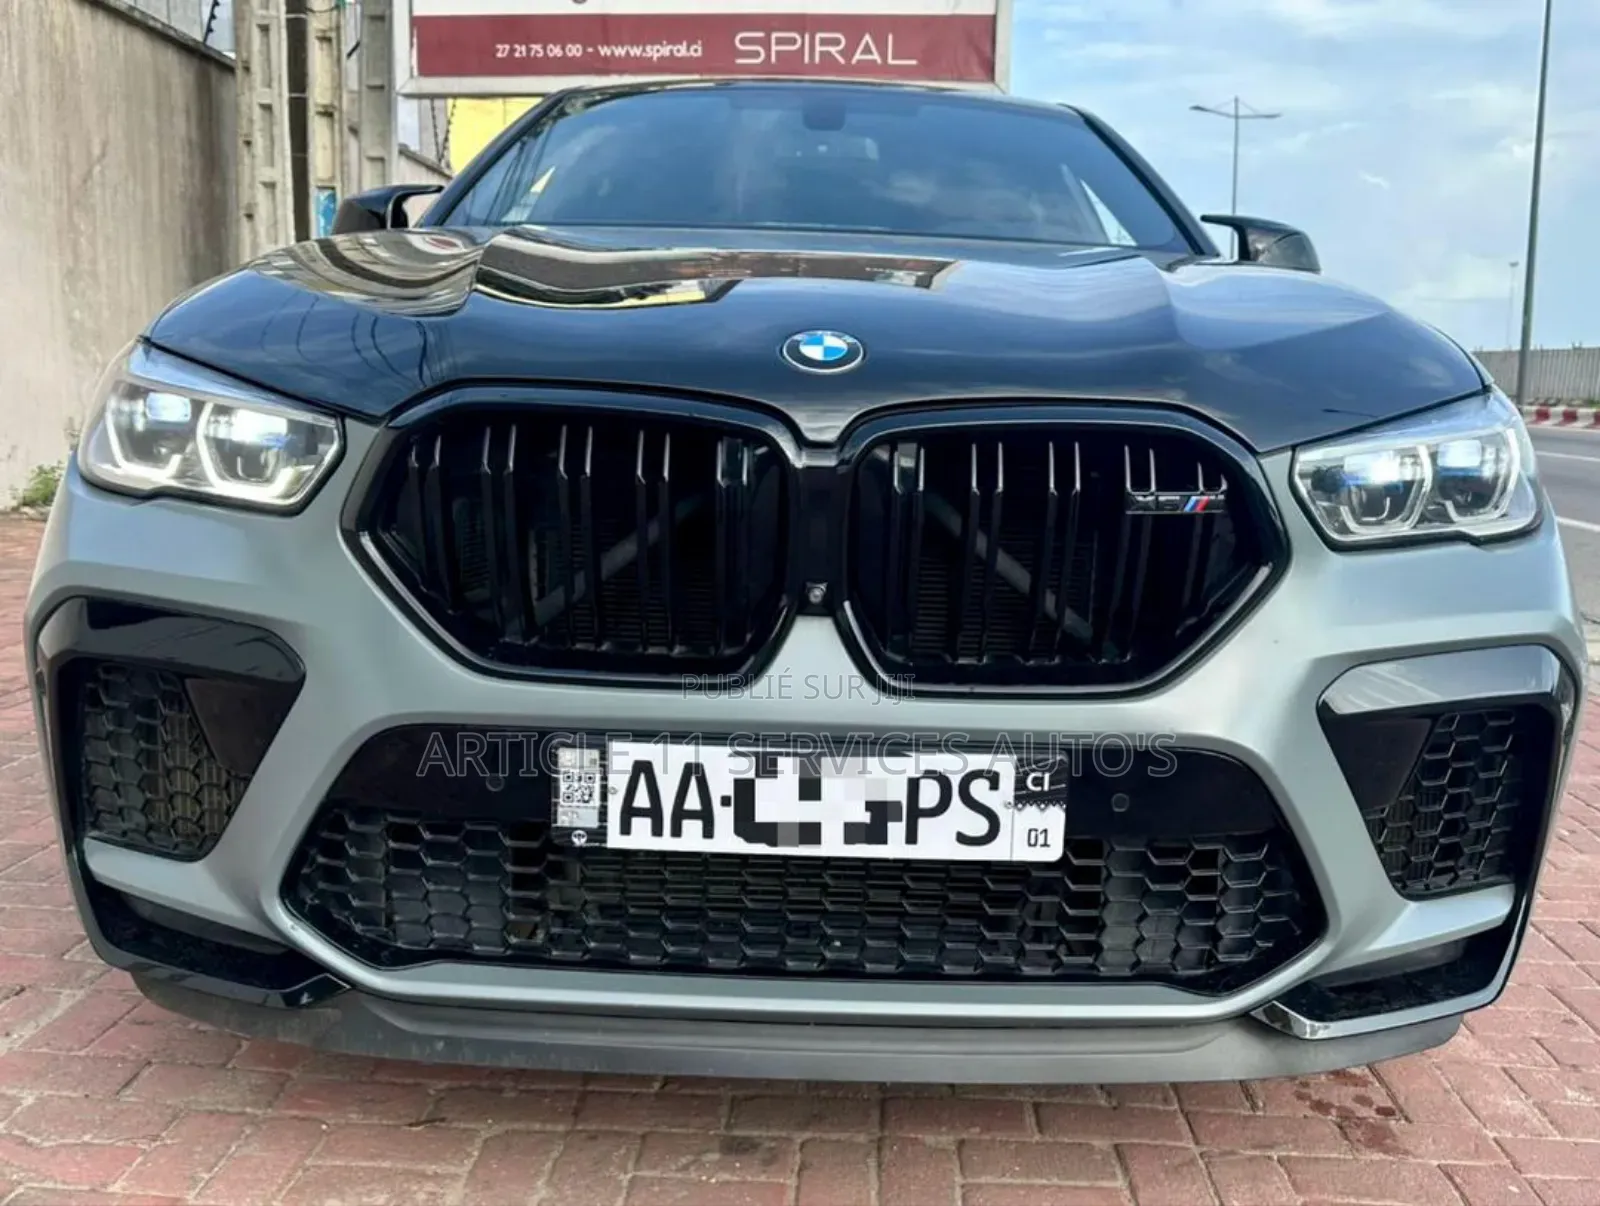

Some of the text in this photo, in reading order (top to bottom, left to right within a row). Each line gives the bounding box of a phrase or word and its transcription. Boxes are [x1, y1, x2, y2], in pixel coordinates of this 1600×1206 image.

[495, 43, 510, 58] 27
[513, 43, 527, 58] 21
[529, 43, 543, 58] 75
[546, 43, 563, 58] 06
[566, 43, 583, 58] 00
[598, 39, 702, 61] www.spiral.ci
[734, 31, 918, 65] SPIRAL
[1027, 828, 1051, 848] 01
